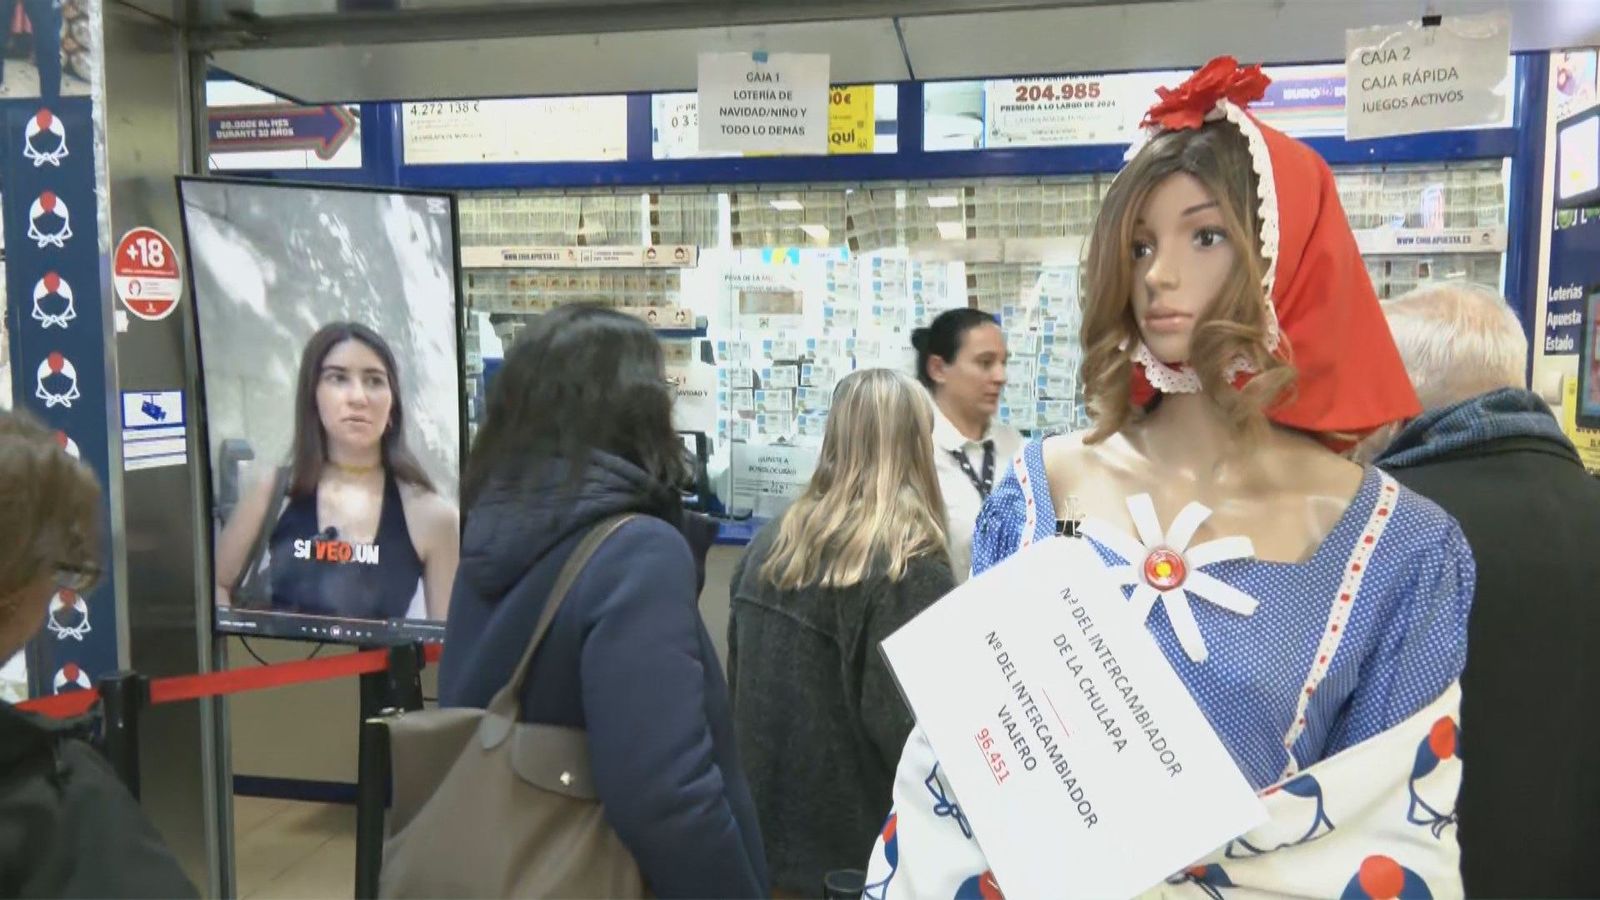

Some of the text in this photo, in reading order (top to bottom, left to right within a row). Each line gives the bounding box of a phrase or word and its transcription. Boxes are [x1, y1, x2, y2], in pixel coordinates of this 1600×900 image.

[1361, 46, 1411, 66] CAJA 2
[746, 72, 780, 82] CAJA 1
[1361, 66, 1459, 91] CAJA RÁPIDA
[733, 88, 792, 100] LOTERÍA DE
[1015, 82, 1101, 102] 204.985
[1362, 89, 1464, 113] JUEGOS ACTIVOS
[800, 108, 807, 118] Y
[1000, 104, 1035, 112] PREMIOS
[1056, 102, 1082, 110] LARGO
[1097, 100, 1116, 108] 2024
[216, 129, 256, 139] DURANTE
[721, 124, 750, 134] TODO
[753, 125, 766, 135] LO
[126, 238, 165, 268] +18
[1548, 284, 1583, 302] Loterías
[1546, 334, 1574, 351] Estado
[294, 538, 380, 565] SI VEO UN
[1053, 634, 1128, 753] DE LA CHULAPA
[1072, 606, 1094, 636] DEL
[1088, 633, 1182, 778] INTERCAMBIADOR
[996, 652, 1017, 682] DEL
[1012, 680, 1098, 829] INTERCAMBIADOR
[998, 704, 1037, 772] VIAJERO
[977, 728, 1010, 783] 96.451
